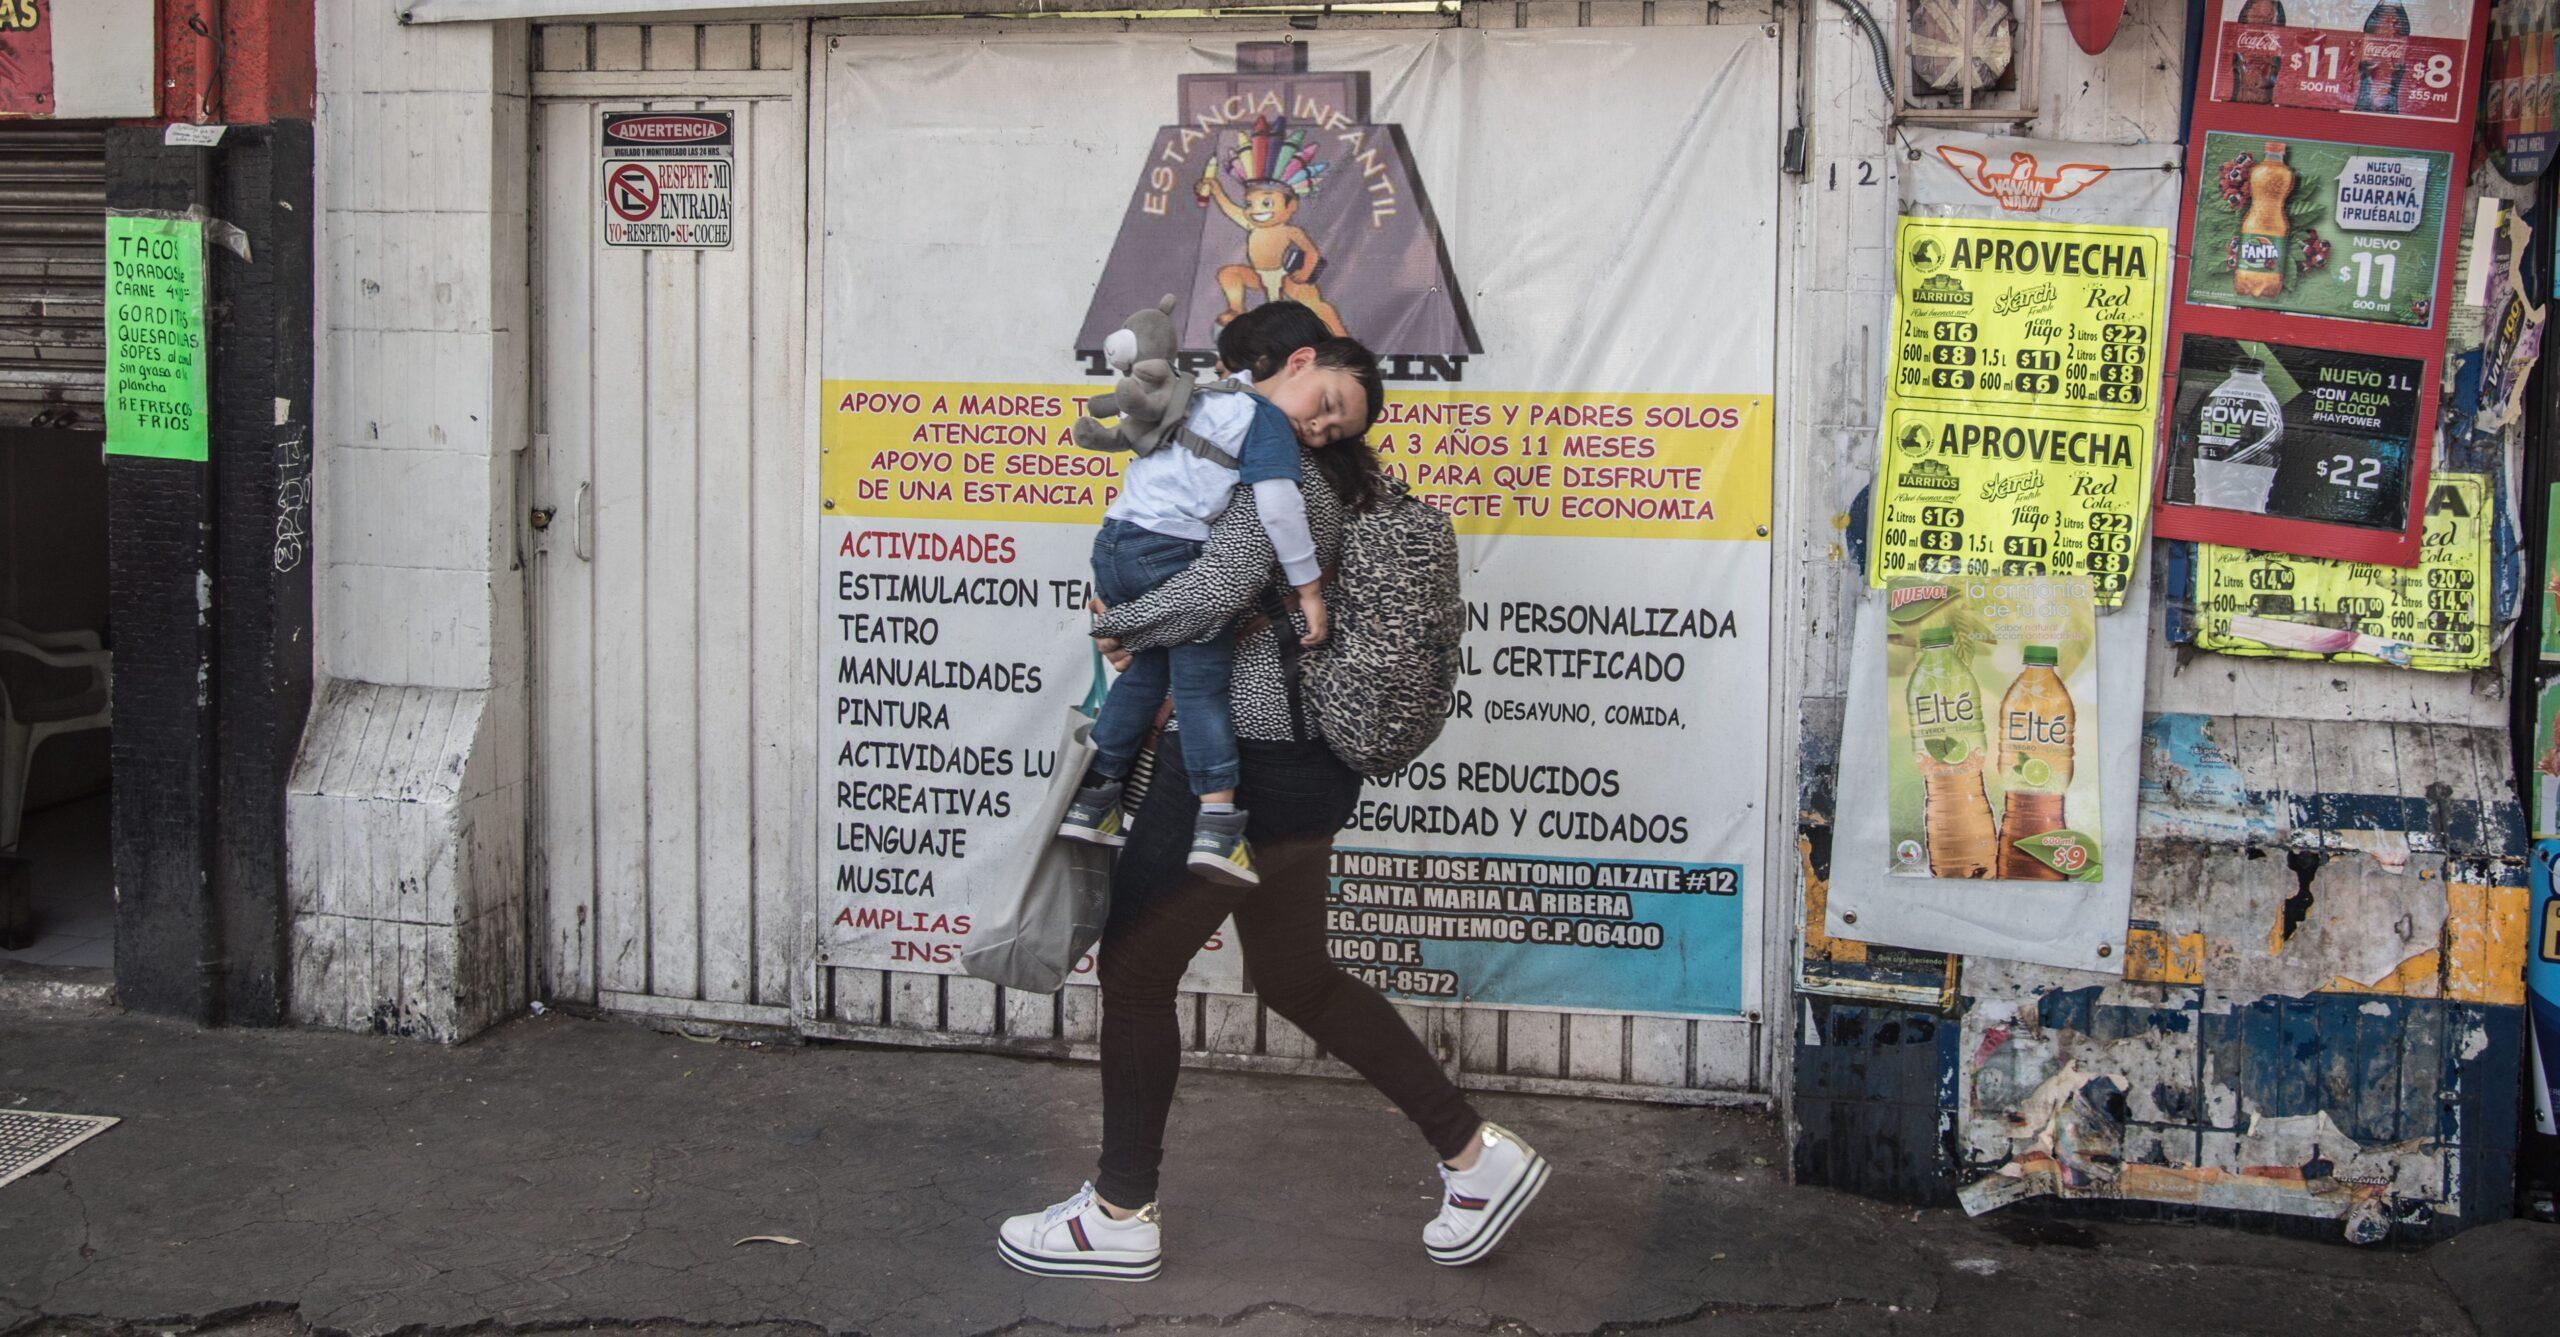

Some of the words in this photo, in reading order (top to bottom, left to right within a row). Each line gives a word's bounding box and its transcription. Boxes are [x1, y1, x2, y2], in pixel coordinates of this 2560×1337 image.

[2290, 44, 2340, 80] $11
[2413, 54, 2453, 88] $8
[2300, 81, 2323, 92] 500
[2325, 83, 2340, 94] ml
[2408, 90, 2430, 100] 355
[2433, 91, 2448, 102] ml
[619, 122, 718, 138] ADVERTENCIA
[614, 148, 641, 157] VIGILADO
[646, 148, 687, 157] MONITOREADO
[687, 148, 699, 157] LAS
[699, 148, 707, 157] 24
[1143, 90, 1287, 217] ESTANCIA
[1292, 94, 1398, 229] INFANTIL
[658, 164, 709, 189] RESPETE
[2366, 161, 2401, 174] NUEVO
[659, 193, 729, 220] ENTRADA
[694, 224, 728, 243] COCHE
[2352, 236, 2401, 251] NUEVO
[1950, 237, 2148, 279] APROVECHA
[2339, 251, 2396, 301] $11
[115, 281, 155, 298] CARNE
[1915, 291, 1971, 304] JARRITOS
[2085, 285, 2131, 309] Red
[2095, 308, 2126, 322] Cola
[2352, 300, 2375, 311] 600
[2377, 301, 2392, 312] ml
[1904, 319, 1911, 337] 2
[1913, 328, 1929, 339] Litros
[1936, 322, 1973, 342] $16
[2024, 320, 2063, 346] Jugo
[2068, 322, 2075, 340] 3
[2077, 330, 2098, 342] Litros
[2105, 325, 2143, 344] $22
[120, 343, 161, 361] SOPES
[1903, 343, 1922, 362] 600
[1982, 348, 2000, 367] 1.5
[2021, 350, 2056, 370] $11
[2066, 342, 2074, 360] 2
[2076, 350, 2097, 361] Litros
[2103, 345, 2140, 365] $16
[119, 362, 136, 374] sin
[138, 364, 172, 381] grasa
[1900, 367, 1921, 386] 500
[1980, 372, 2001, 390] 600
[2066, 363, 2088, 380] 600
[2319, 366, 2382, 388] NUEVO
[119, 378, 167, 394] plancha
[2064, 383, 2086, 400] 500
[2316, 387, 2346, 401] CON
[2349, 391, 2390, 407] AGUA
[839, 392, 921, 415] APOYO
[931, 395, 949, 415] A
[959, 395, 1062, 417] MADRES
[1505, 404, 1520, 426] Y
[1530, 404, 1633, 428] PADRES
[1644, 406, 1740, 430] SOLOS
[2314, 399, 2334, 413] DE
[2337, 401, 2377, 417] COCO
[138, 413, 190, 432] FRIOS
[2312, 412, 2381, 428] #HAYPOWER
[912, 423, 1047, 446] ATENCION
[1407, 433, 1422, 455] 3
[1434, 428, 1509, 457] AÑOS
[1521, 435, 1549, 456] 11
[1562, 436, 1656, 458] MESES
[1938, 422, 2133, 468] APROVECHA
[871, 451, 952, 473] APOYO
[963, 453, 995, 474] DE
[1005, 454, 1119, 478] SEDESOL
[2316, 453, 2382, 490] $22
[1418, 464, 1483, 486] PARA
[1493, 464, 1551, 489] QUE
[1562, 467, 1702, 491] DISFRUTE
[1899, 476, 1959, 489] JARRITOS
[2070, 473, 2118, 496] Red
[858, 478, 889, 500] DE
[899, 481, 952, 501] UNA
[963, 481, 1094, 506] ESTANCIA
[2082, 496, 2112, 510] Cola
[1513, 496, 1550, 518] TU
[1562, 496, 1715, 521] ECONOMIA
[1924, 507, 1960, 527] $16
[2011, 506, 2049, 532] Jugo
[839, 530, 1016, 564] ACTIVIDADES
[1968, 533, 1987, 552] 1.5
[838, 571, 1039, 607] ESTIMULACION
[2223, 576, 2244, 588] Litros
[1891, 585, 1948, 611] NUEVO!
[838, 613, 939, 645] TEATRO
[1499, 601, 1738, 640] PERSONALIZADA
[838, 656, 1043, 693] MANUALIDADES
[1493, 646, 1685, 683] CERTIFICADO
[837, 697, 950, 730] PINTURA
[1484, 700, 1596, 728] (DESAYUNO,
[1604, 704, 1687, 730] COMIDA,
[1915, 691, 1974, 726] Elté
[2008, 711, 2066, 744] Elté
[838, 740, 1014, 776] ACTIVIDADES
[1457, 761, 1620, 798] REDUCIDOS
[837, 780, 1011, 818] RECREATIVAS
[1509, 808, 1527, 838] Y
[1538, 809, 1689, 844] CUIDADOS
[836, 822, 967, 859] LENGUAJE
[2053, 845, 2087, 870] $9
[836, 864, 935, 898] MUSICA
[1344, 854, 1420, 879] NORTE
[1423, 858, 1481, 882] JOSE
[1484, 860, 1592, 887] ANTONIO
[1596, 865, 1681, 891] ALZATE
[1686, 869, 1736, 893] #12
[1342, 882, 1419, 907] SANTA
[1423, 886, 1502, 911] MARIA
[1507, 890, 1536, 913] LA
[1540, 892, 1630, 917] RIBERA
[834, 907, 972, 935] AMPLIAS
[1326, 909, 1526, 941] EG.CUAUHTEMOC
[1530, 921, 1573, 943] C.P.
[1577, 922, 1661, 947] 06400
[1381, 941, 1421, 963] D.F.
